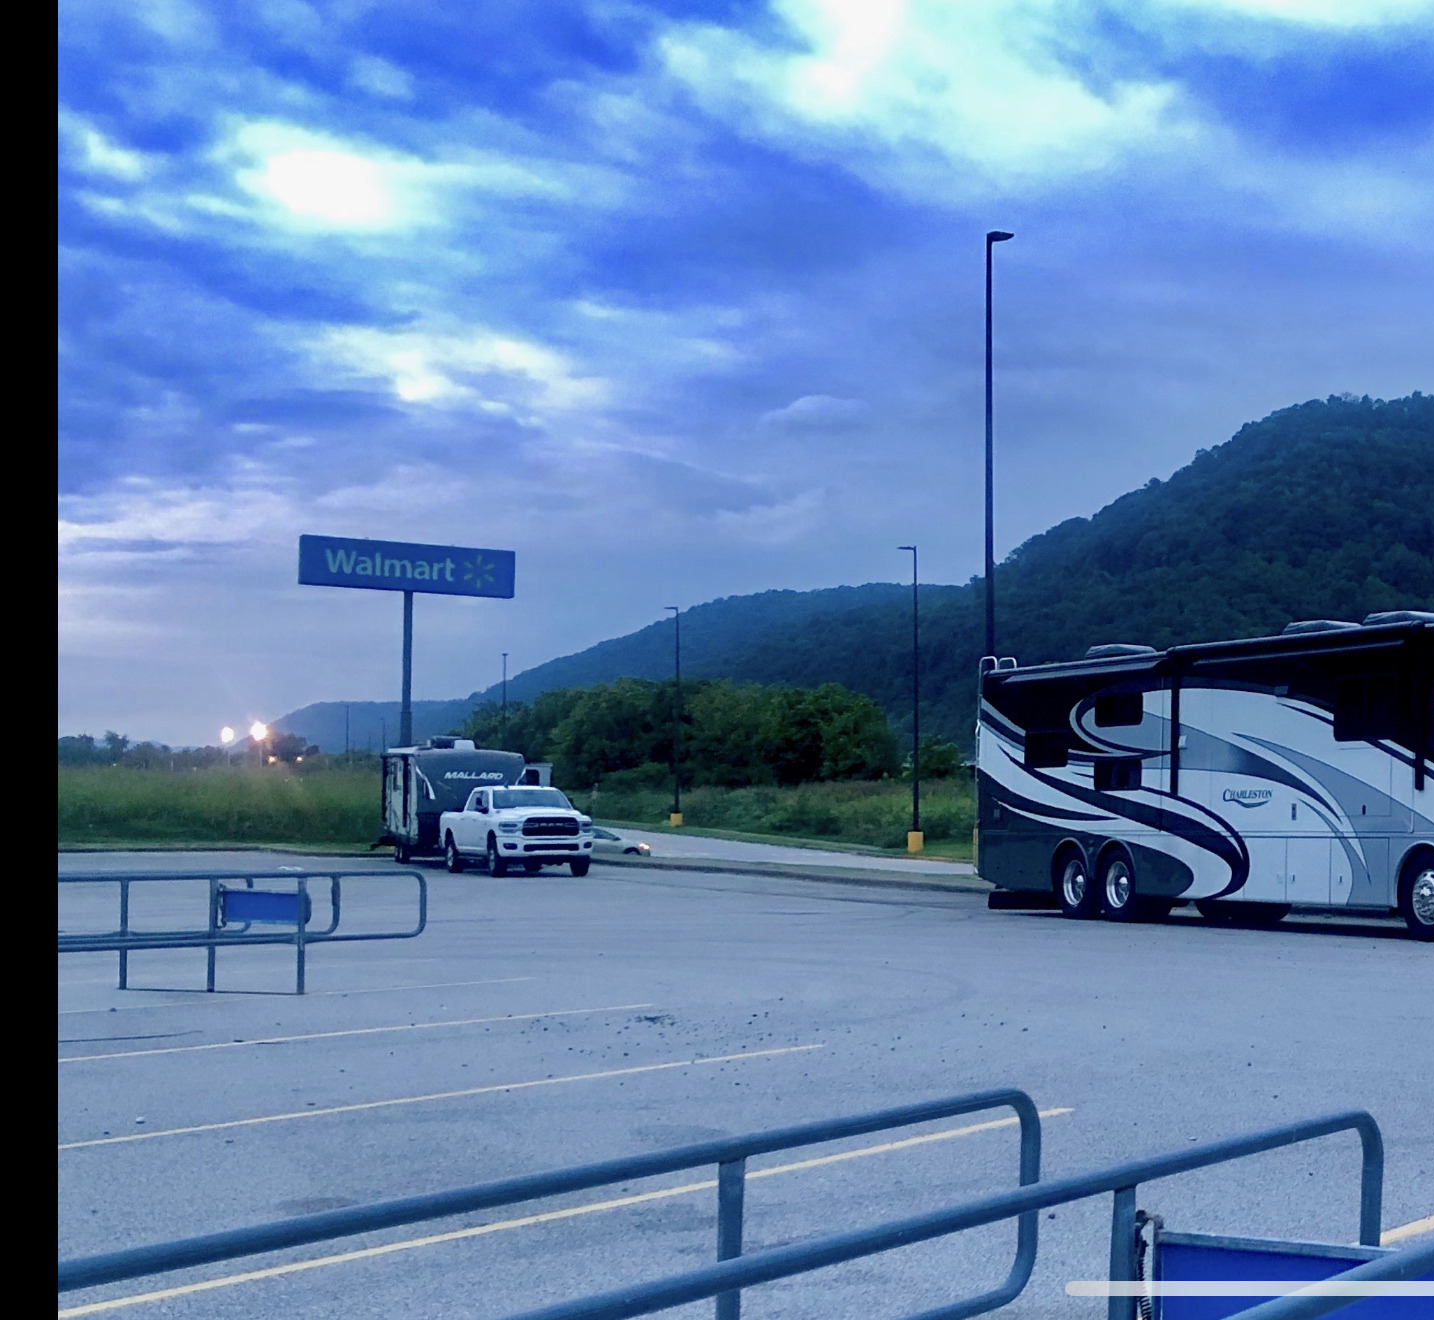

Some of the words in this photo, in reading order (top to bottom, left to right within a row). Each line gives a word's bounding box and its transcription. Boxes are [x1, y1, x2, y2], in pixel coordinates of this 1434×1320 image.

[325, 548, 456, 582] Walmart
[443, 771, 504, 781] MALLARD
[1222, 788, 1273, 802] CHARLESTON
